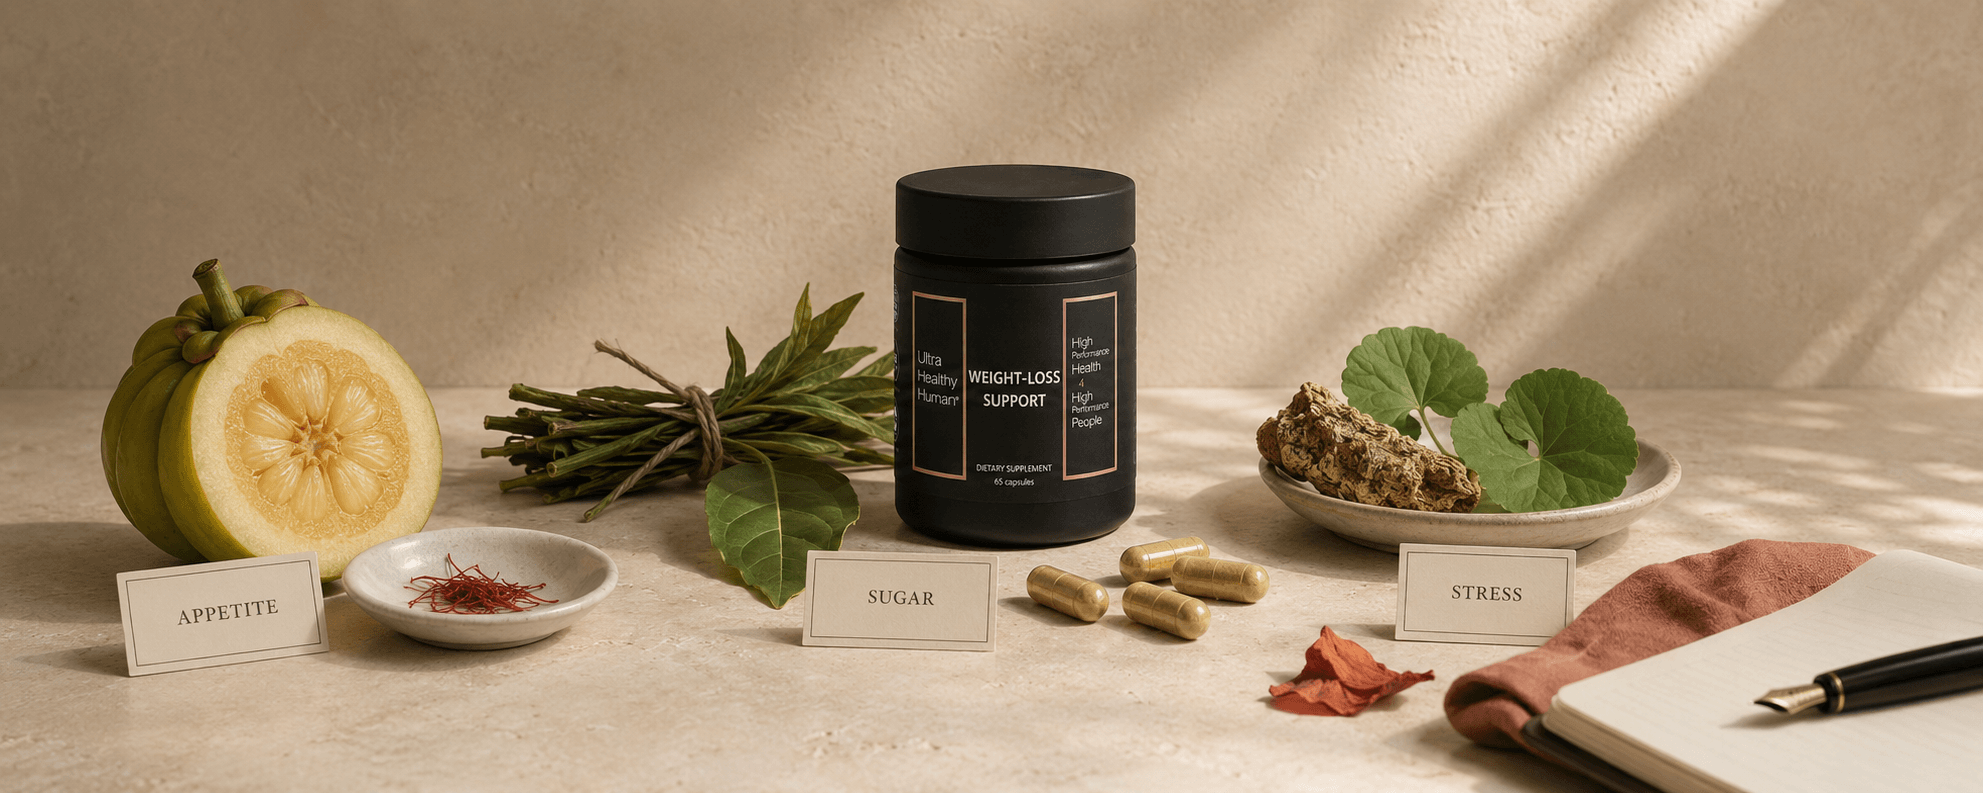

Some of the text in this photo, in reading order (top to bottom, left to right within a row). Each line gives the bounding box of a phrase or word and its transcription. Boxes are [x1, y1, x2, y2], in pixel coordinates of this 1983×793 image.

[1071, 336, 1094, 350] High
[917, 350, 942, 367] Ultra
[1071, 361, 1102, 375] Health
[917, 369, 958, 391] Healthy
[968, 369, 1061, 385] WEIGHT-LOSS
[1078, 378, 1085, 388] 4
[983, 393, 1047, 408] SUPPORT
[1071, 391, 1094, 406] High
[1071, 415, 1103, 429] People
[976, 463, 1053, 473] DIETARY SUPPLEMENT
[993, 478, 1035, 488] 65 capsules
[867, 588, 935, 607] SUGAR
[1451, 583, 1523, 603] STRESS
[176, 598, 280, 626] APPETITE
